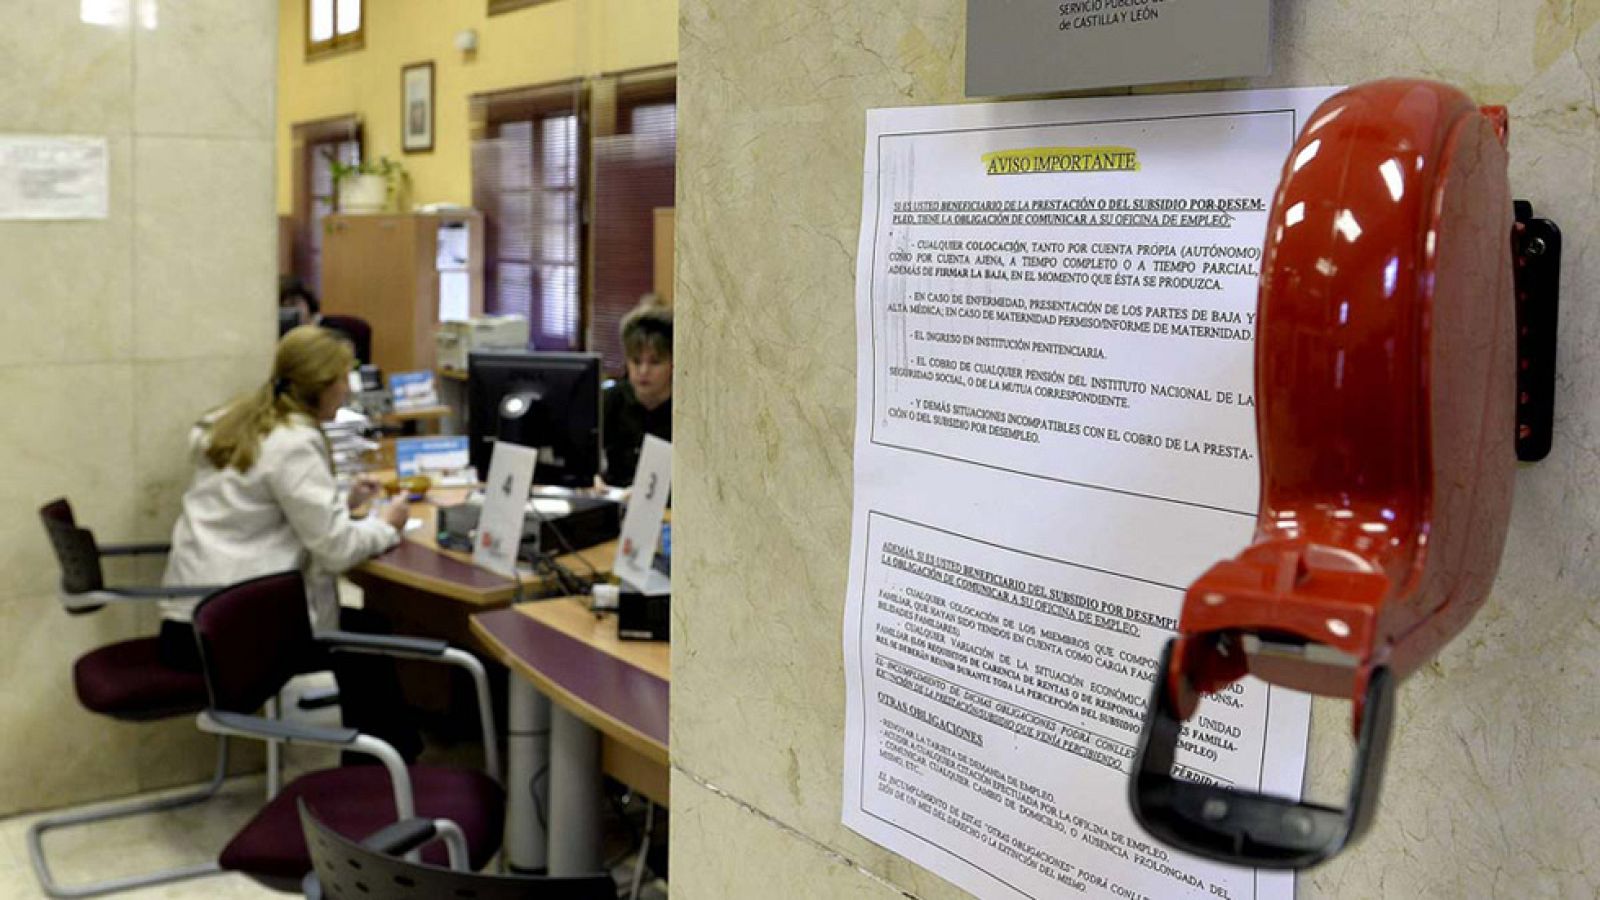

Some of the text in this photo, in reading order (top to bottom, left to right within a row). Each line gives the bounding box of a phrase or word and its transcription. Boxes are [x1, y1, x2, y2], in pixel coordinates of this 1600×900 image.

[1059, 1, 1102, 16] SERVICIO
[1059, 6, 1158, 30] de CASTILLA Y LEÓN
[989, 153, 1135, 173] AVISO IMPORTANTE
[941, 201, 1002, 211] BENEFICIARIO
[1004, 201, 1016, 211] DE
[1018, 201, 1030, 211] LA
[1032, 198, 1094, 211] PRESTACIÓN
[1108, 200, 1130, 210] DEL
[1133, 199, 1188, 210] SUBSIDIO
[1190, 199, 1214, 210] POR
[1218, 198, 1265, 210] DESEM-
[954, 212, 1010, 225] OBLIGACIÓN
[1012, 214, 1022, 225] DE
[1024, 214, 1088, 225] COMUNICAR
[1090, 214, 1098, 225] A
[1100, 214, 1114, 225] SU
[1116, 214, 1158, 225] OFICINA
[1162, 215, 1178, 226] DE
[917, 239, 963, 251] CUALQUIER
[1032, 242, 1064, 253] TANTO
[1068, 243, 1088, 253] POR
[1092, 243, 1132, 254] CUENTA
[1180, 244, 1260, 260] (AUTÓNOMO)
[936, 253, 969, 264] CUENTA
[1009, 256, 1016, 266] A
[1022, 257, 1056, 267] TIEMPO
[1063, 258, 1117, 269] COMPLETO
[1123, 259, 1132, 270] O
[1138, 260, 1146, 270] A
[1153, 260, 1196, 272] TIEMPO
[1202, 262, 1258, 275] PARCIAL,
[935, 267, 968, 278] FIRMAR
[970, 269, 982, 279] LA
[1011, 271, 1022, 281] EN
[1024, 271, 1035, 281] EL
[1038, 272, 1088, 284] MOMENTO
[1091, 274, 1112, 286] QUE
[1114, 272, 1140, 286] ÉSTA
[1142, 276, 1156, 287] SE
[1158, 277, 1222, 289] PRODUZCA.
[914, 292, 924, 302] EN
[927, 292, 950, 303] CASO
[952, 294, 963, 304] DE
[1030, 299, 1102, 313] PRESENTACIÓN
[1104, 304, 1118, 314] DE
[1122, 305, 1142, 316] LOS
[1146, 307, 1187, 319] PARTES
[1192, 310, 1208, 320] DE
[1212, 311, 1241, 322] BAJA
[1247, 313, 1256, 323] Y
[945, 307, 957, 317] EN
[958, 308, 981, 319] CASO
[982, 310, 994, 320] DE
[996, 311, 1056, 325] MATERNIDAD
[1153, 323, 1169, 334] DE
[1171, 324, 1254, 340] MATERNIDAD.
[914, 330, 924, 340] EL
[926, 331, 960, 344] INGRESO
[962, 334, 974, 345] EN
[976, 335, 1030, 351] INSTITUCIÓN
[916, 356, 1254, 406] EL COBRO DE CUALQUIER PENSIÓN DEL INSTITUTO NACIONAL DE LA
[967, 377, 974, 386] O
[976, 378, 987, 388] DE
[989, 379, 1000, 390] LA
[1001, 381, 1032, 395] MUTUA
[1034, 386, 1130, 409] CORRESPONDIENTE.
[916, 412, 932, 423] DEL
[934, 415, 970, 430] SUBSIDIO
[971, 421, 986, 433] POR
[988, 424, 1040, 443] DESEMPLEO.
[916, 398, 1254, 460] Y DEMÁS SITUACIONES INCOMPATIBLES CON EL COBRO DE LA PRESTA-
[502, 474, 513, 497] 4
[964, 564, 1122, 618] BENEFICIARIO DEL SUBSIDIO POR
[1035, 600, 1092, 624] OFICINA DE
[1003, 617, 1014, 629] DE
[1019, 622, 1035, 635] LOS
[1040, 628, 1089, 651] MIEMBROS
[1094, 643, 1114, 658] QUE
[1026, 637, 1062, 656] CUENTA
[1065, 648, 1092, 666] COMO
[1096, 656, 1128, 675] CARGA
[1000, 654, 1084, 688] DE LA SITUACIÓN
[878, 691, 984, 747] OTRAS OBLIGACIONES
[1080, 705, 1098, 720] DEL
[1199, 715, 1241, 738] UNIDAD
[1192, 729, 1238, 752] FAMILIA-
[1111, 830, 1124, 845] DE
[1082, 832, 1128, 860] AUSENCIA
[1134, 852, 1204, 890] PROLONGADA
